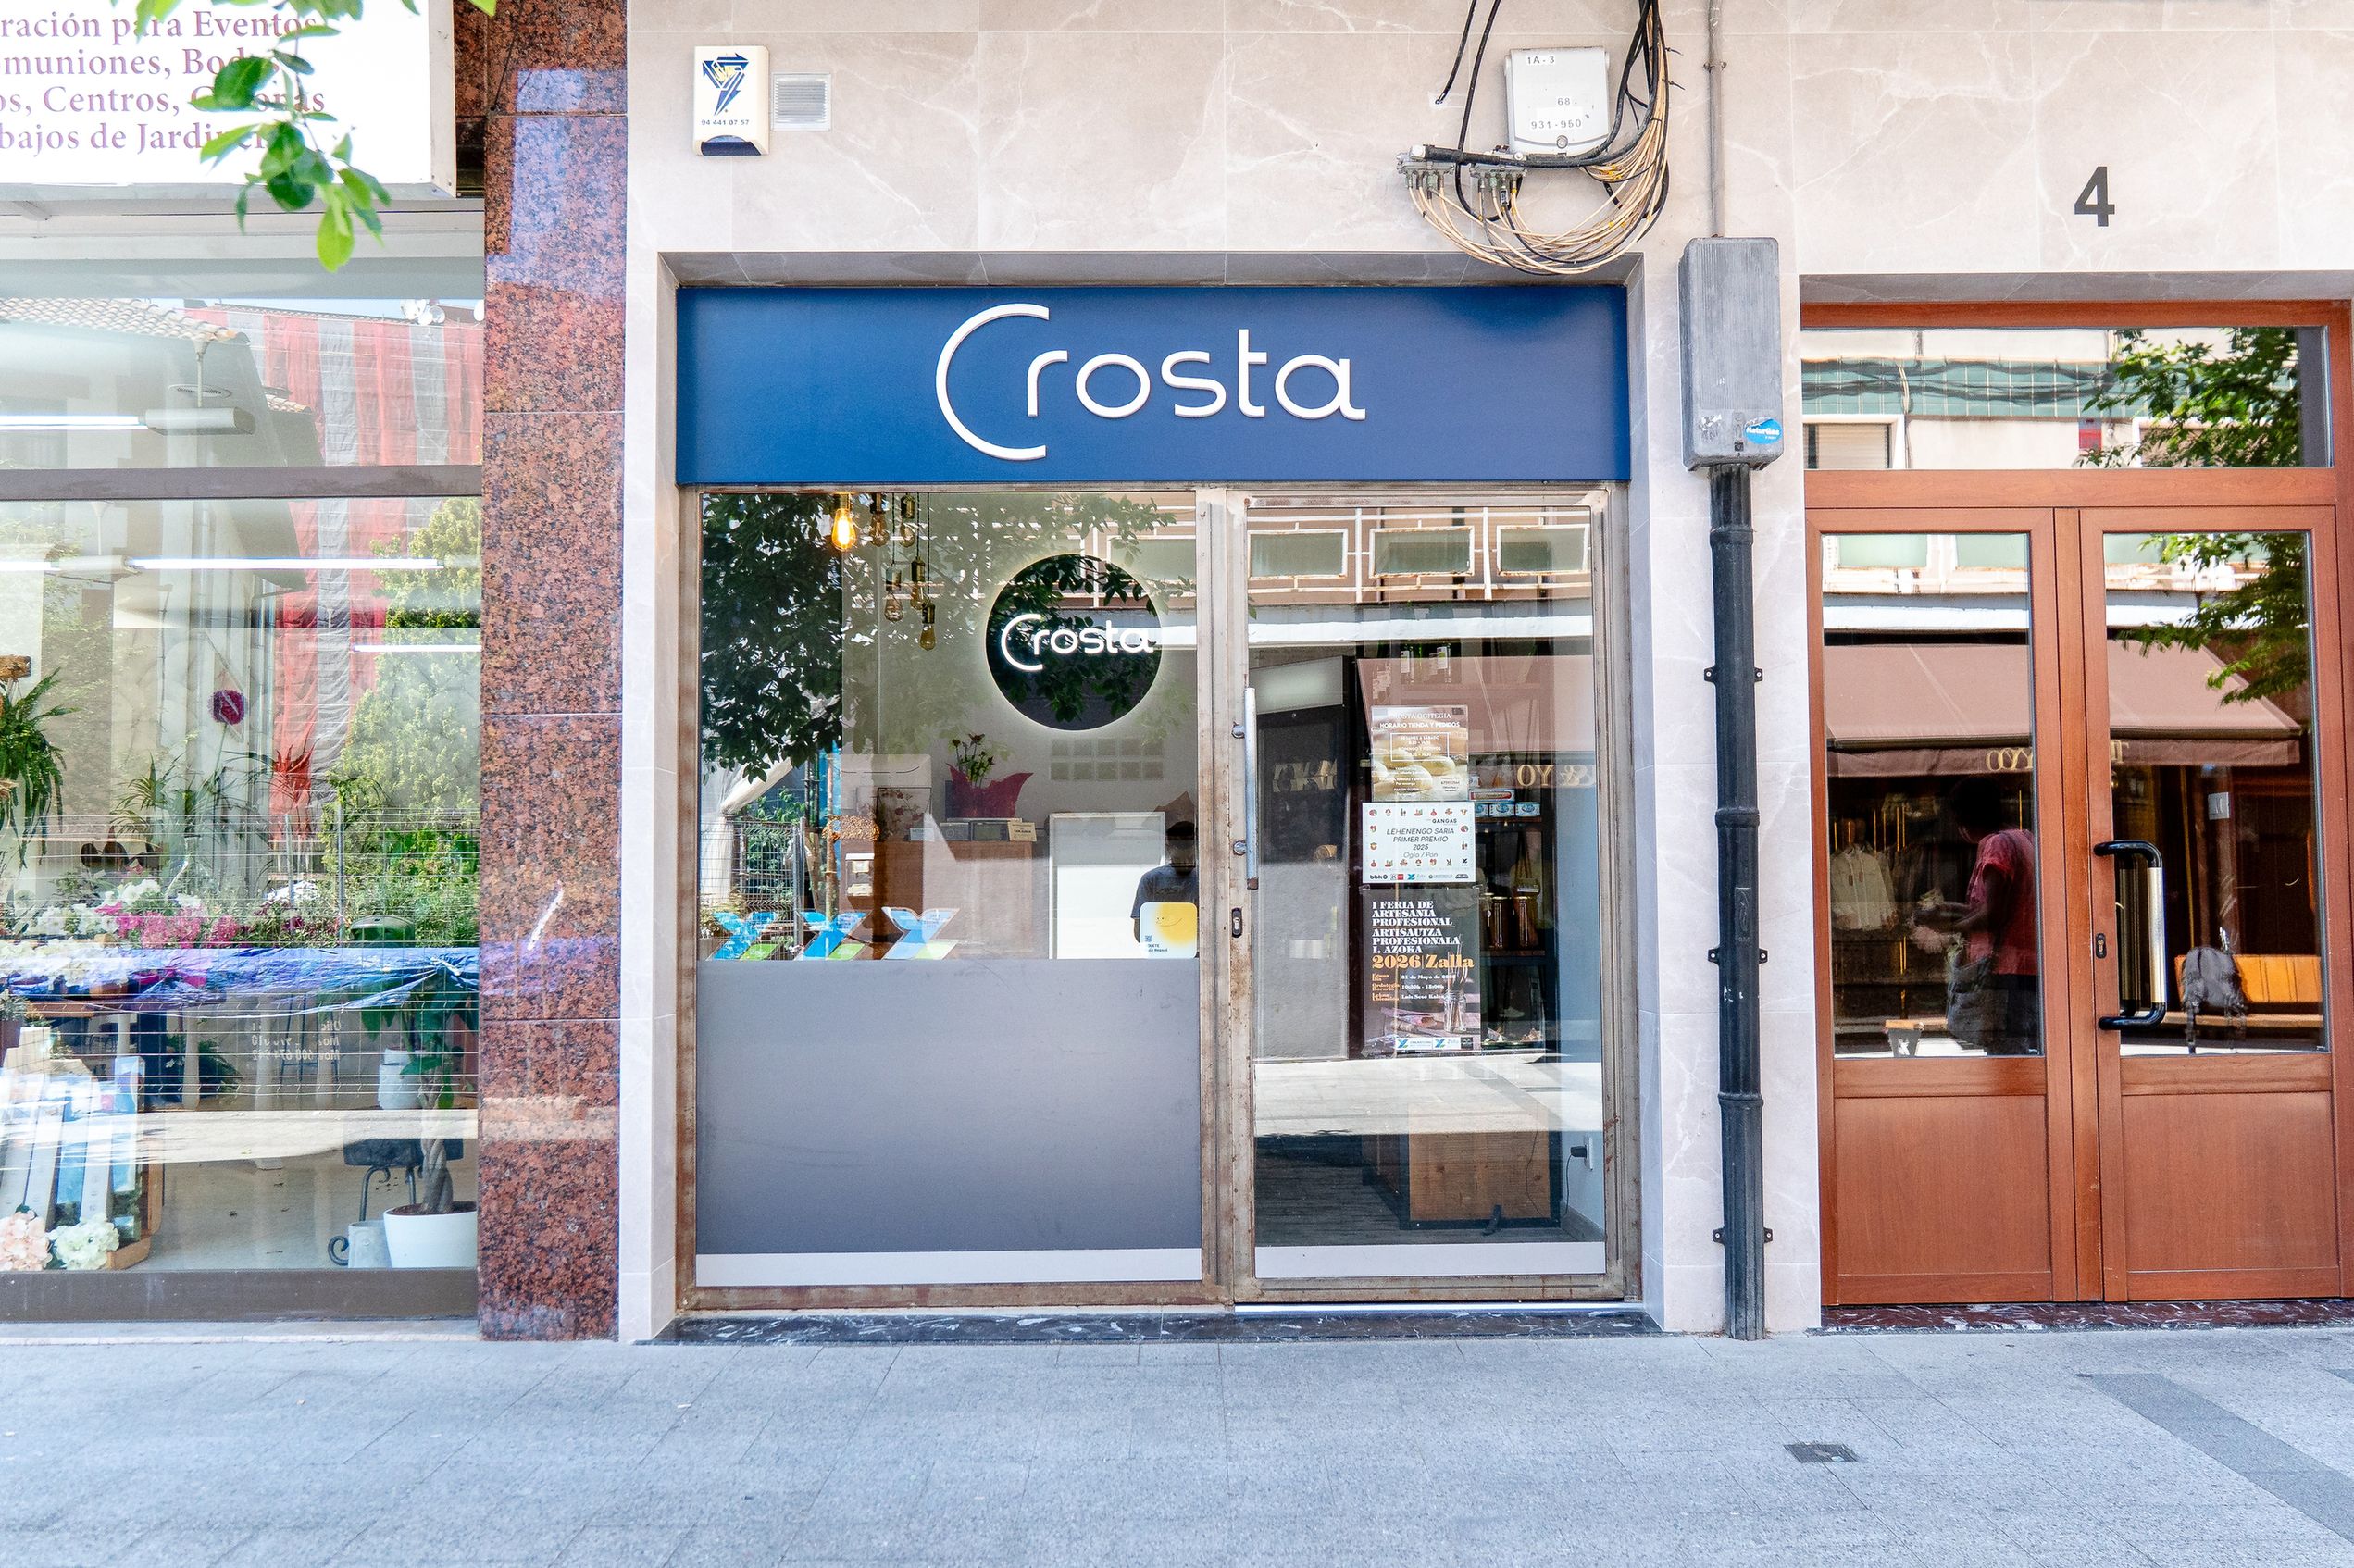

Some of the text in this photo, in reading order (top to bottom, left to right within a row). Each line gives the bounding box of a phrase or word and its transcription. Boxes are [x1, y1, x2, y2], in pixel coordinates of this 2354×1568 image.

[0, 11, 102, 38] ración
[44, 85, 180, 116] Centros,
[0, 122, 80, 157] bajos
[90, 122, 126, 149] de
[2074, 166, 2115, 227] 4
[935, 303, 1366, 461] Crosta
[1001, 613, 1154, 671] Crosta
[1372, 901, 1434, 909] I FERIA DE
[1372, 917, 1453, 926] PROFESIONAL
[1372, 928, 1442, 937] ARTISAUTZA
[1372, 937, 1461, 945] PROFESIONALA
